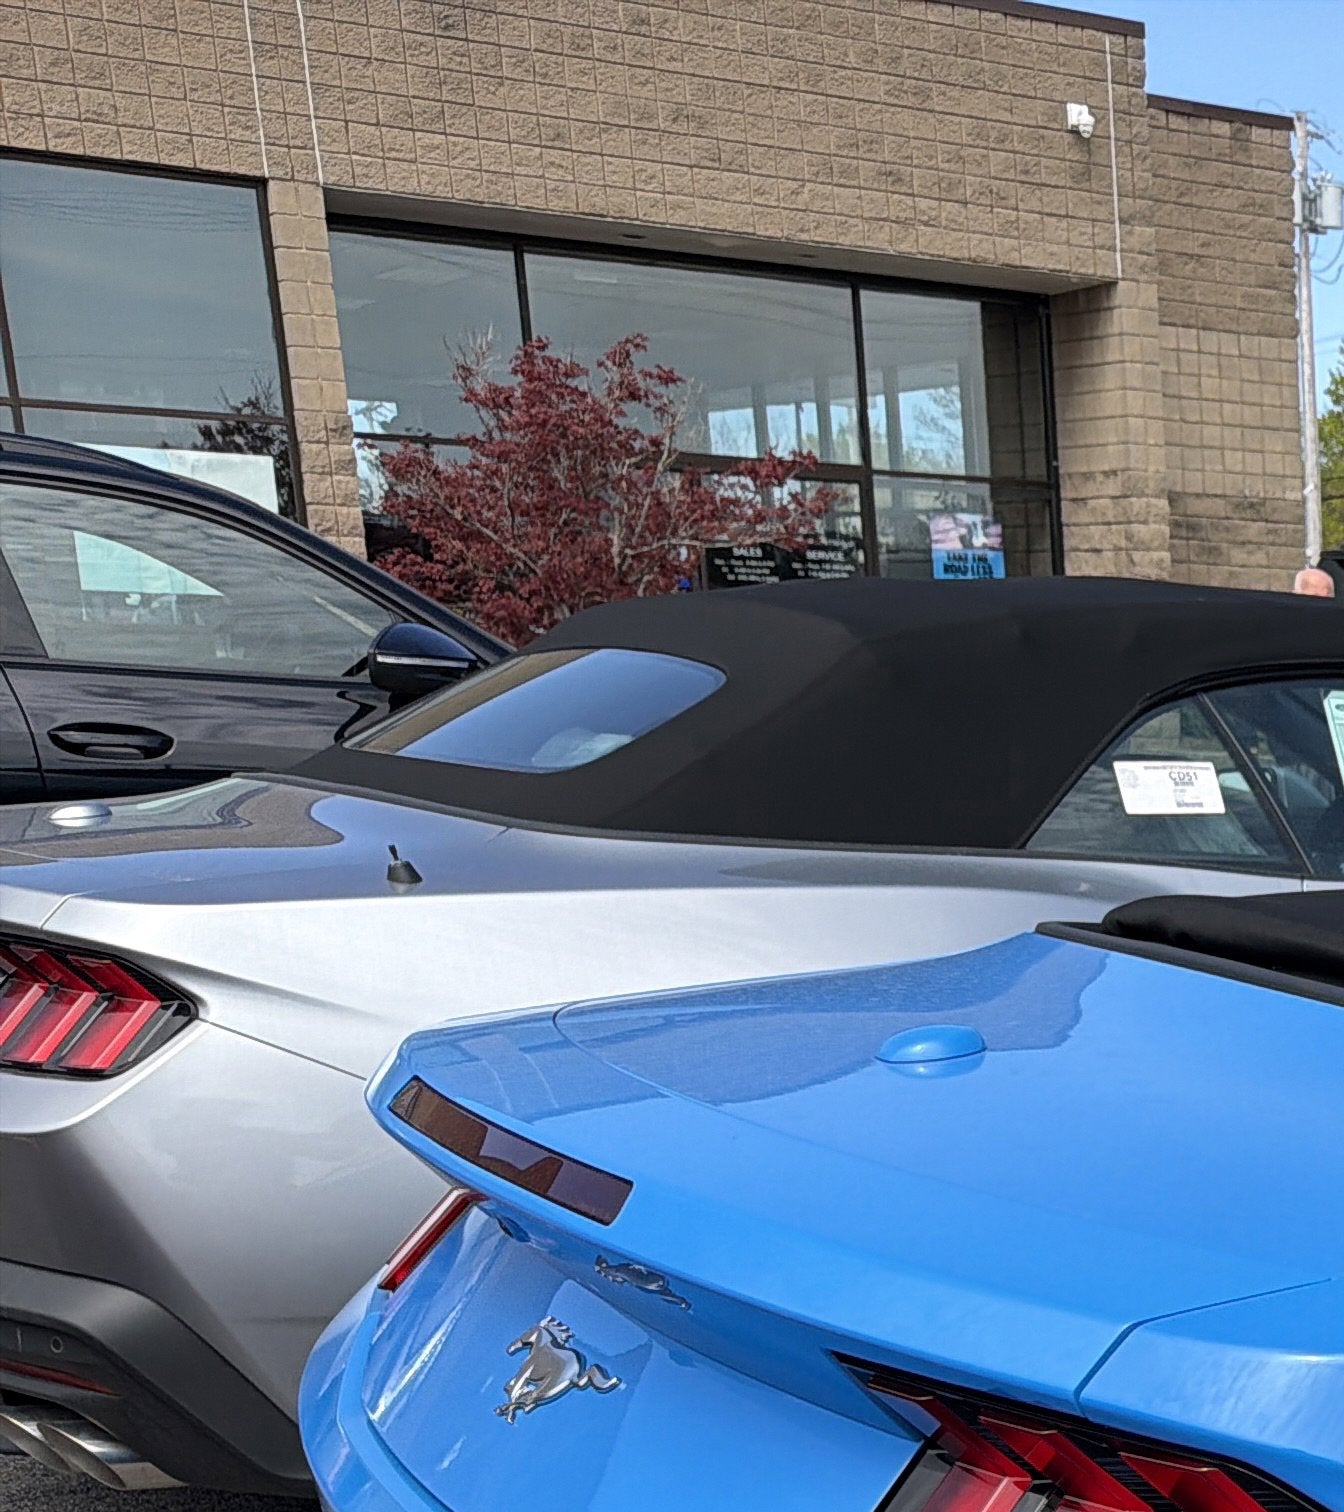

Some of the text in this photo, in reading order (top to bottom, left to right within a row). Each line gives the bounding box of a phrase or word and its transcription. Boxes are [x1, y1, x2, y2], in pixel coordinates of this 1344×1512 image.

[732, 547, 763, 558] SALES
[806, 550, 845, 562] SERVICE
[1168, 770, 1199, 781] CD51
